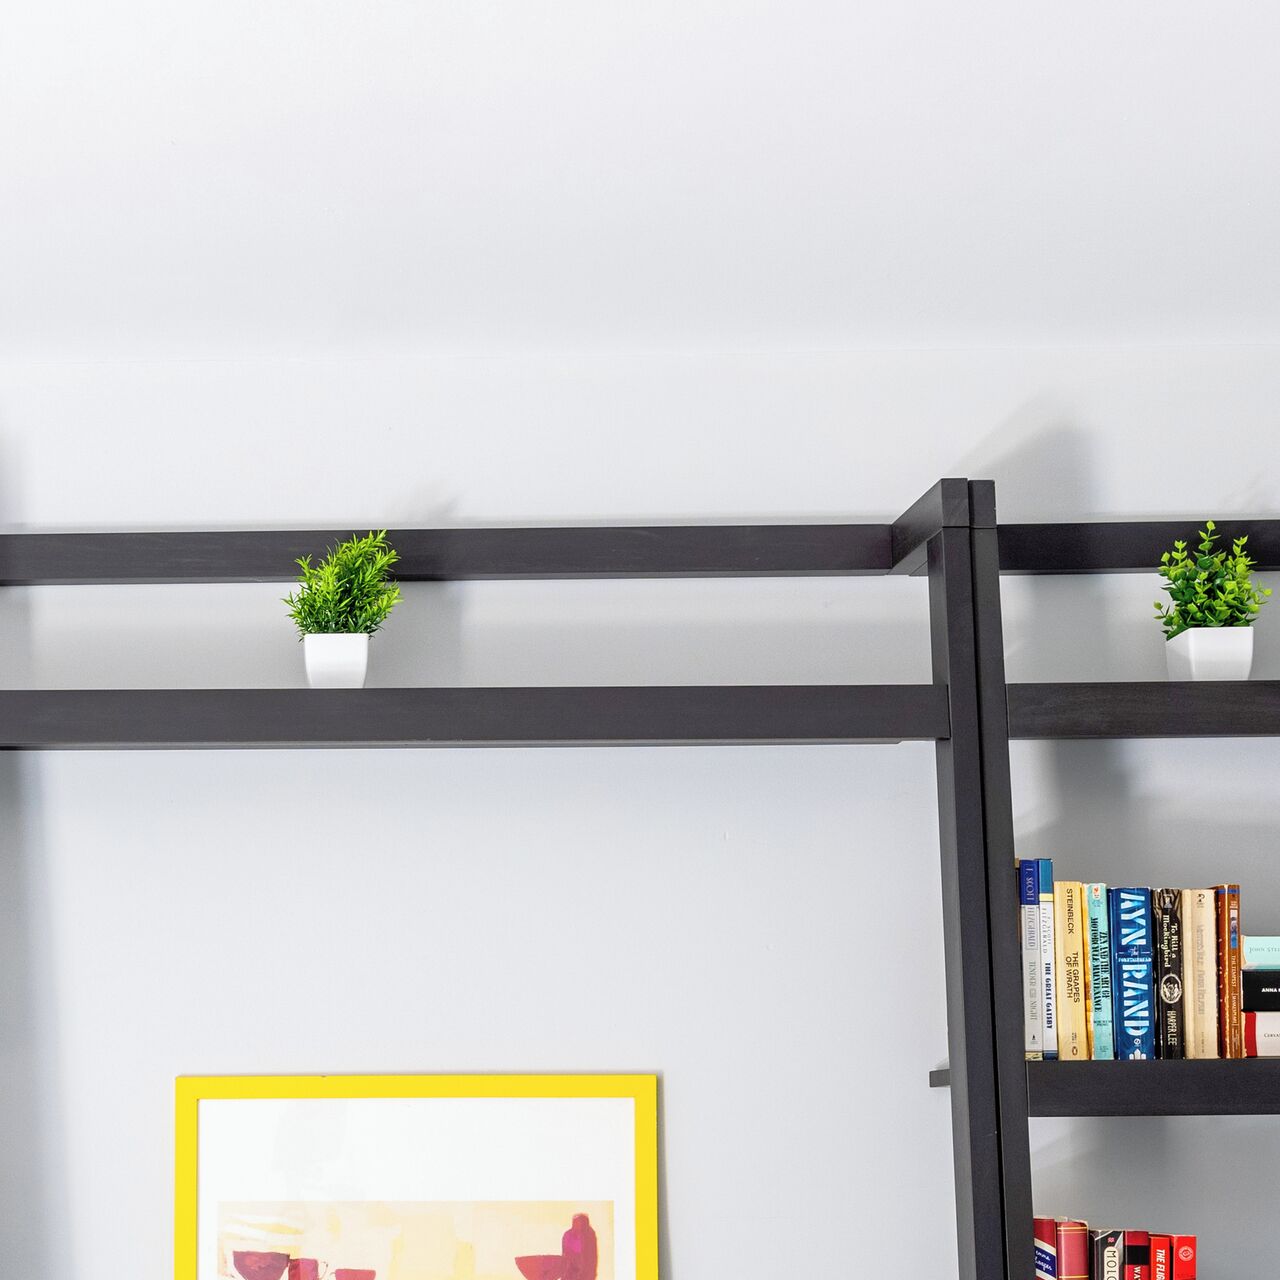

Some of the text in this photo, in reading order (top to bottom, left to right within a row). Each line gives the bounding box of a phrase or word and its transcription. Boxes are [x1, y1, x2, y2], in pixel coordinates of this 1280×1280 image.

[1066, 888, 1075, 935] STEINBECK
[1120, 892, 1147, 946] AYN
[1171, 923, 1178, 934] To
[1161, 915, 1171, 967] Mockingbird
[1171, 935, 1179, 952] Kill
[1065, 956, 1072, 967] OF
[1072, 969, 1081, 1003] GRAPES
[1092, 964, 1102, 1012] MAINTENANCE
[1122, 964, 1150, 1036] RAND
[1167, 1010, 1177, 1046] HARPER LEE
[1156, 1249, 1165, 1262] THE
